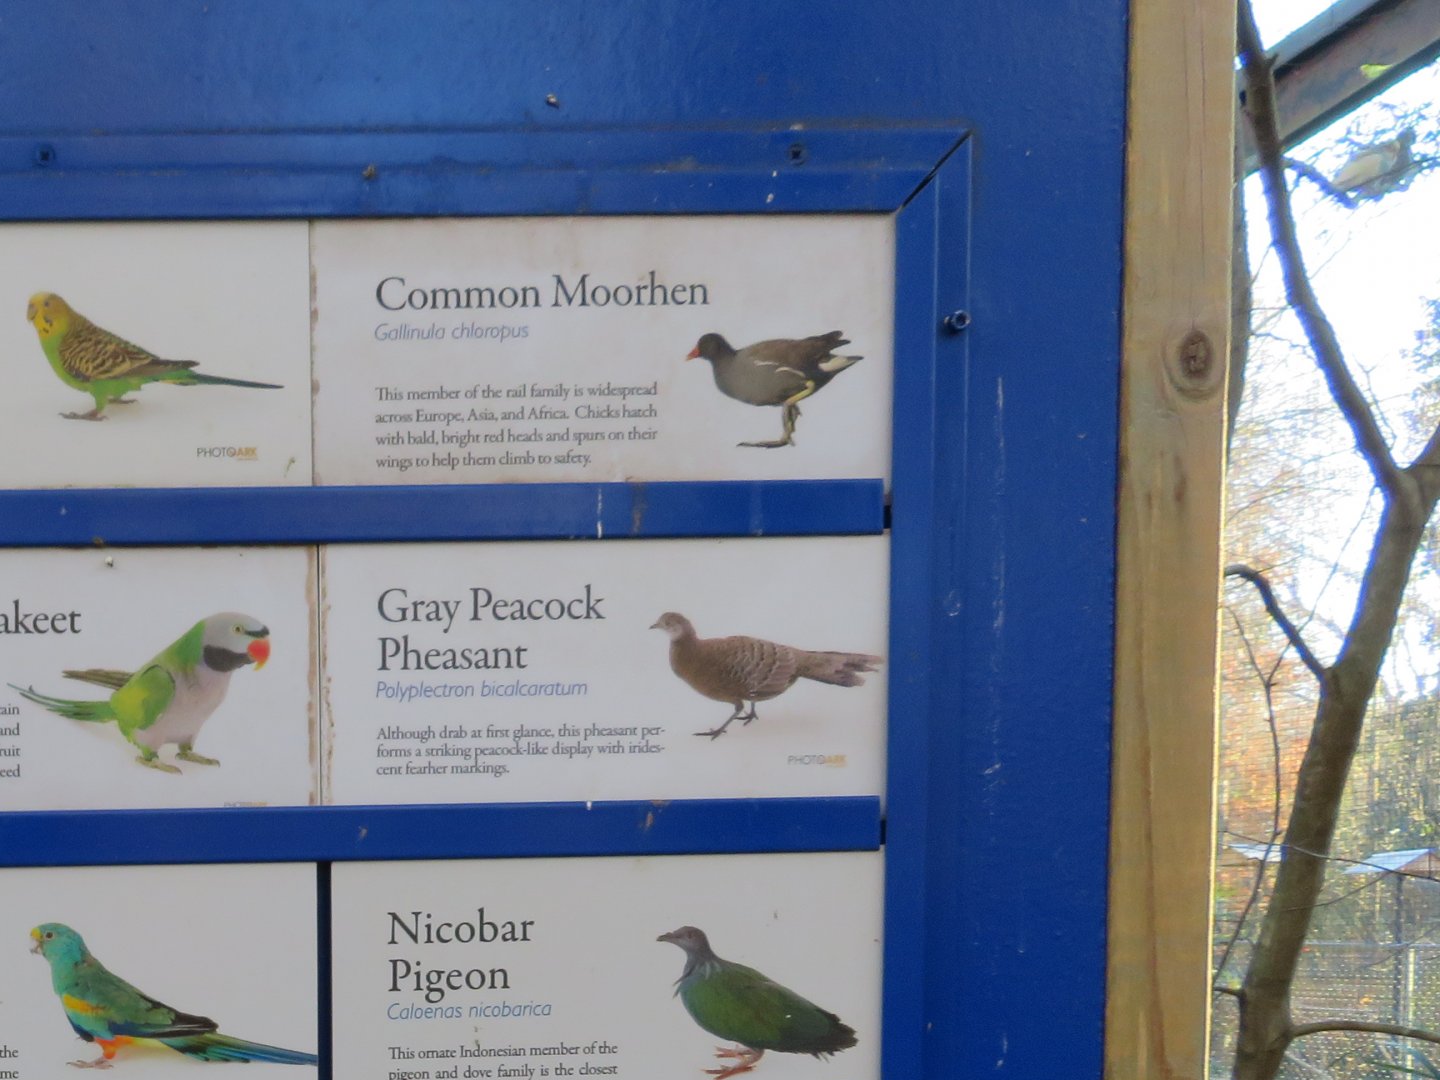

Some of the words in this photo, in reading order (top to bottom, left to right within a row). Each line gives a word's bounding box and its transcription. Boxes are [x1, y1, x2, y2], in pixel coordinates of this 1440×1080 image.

[375, 274, 541, 310] Common
[551, 269, 708, 307] Moorhen
[373, 321, 445, 341] Gallinula
[451, 321, 530, 343] chloropus
[375, 455, 413, 472] wings
[415, 457, 429, 467] to
[431, 451, 459, 471] help
[462, 451, 495, 465] them
[498, 450, 535, 465] climb
[537, 454, 552, 464] to
[553, 448, 591, 467] safety.
[377, 587, 461, 633] Gray
[469, 583, 605, 621] Peacock
[378, 635, 527, 670] Pheasant
[375, 679, 475, 702] Polyplectron
[480, 678, 588, 697] bicalcaratum
[386, 906, 534, 944] Nicobar
[388, 958, 510, 1003] Pigeon
[386, 999, 463, 1020] Caloenas
[468, 999, 551, 1017] nicobarica
